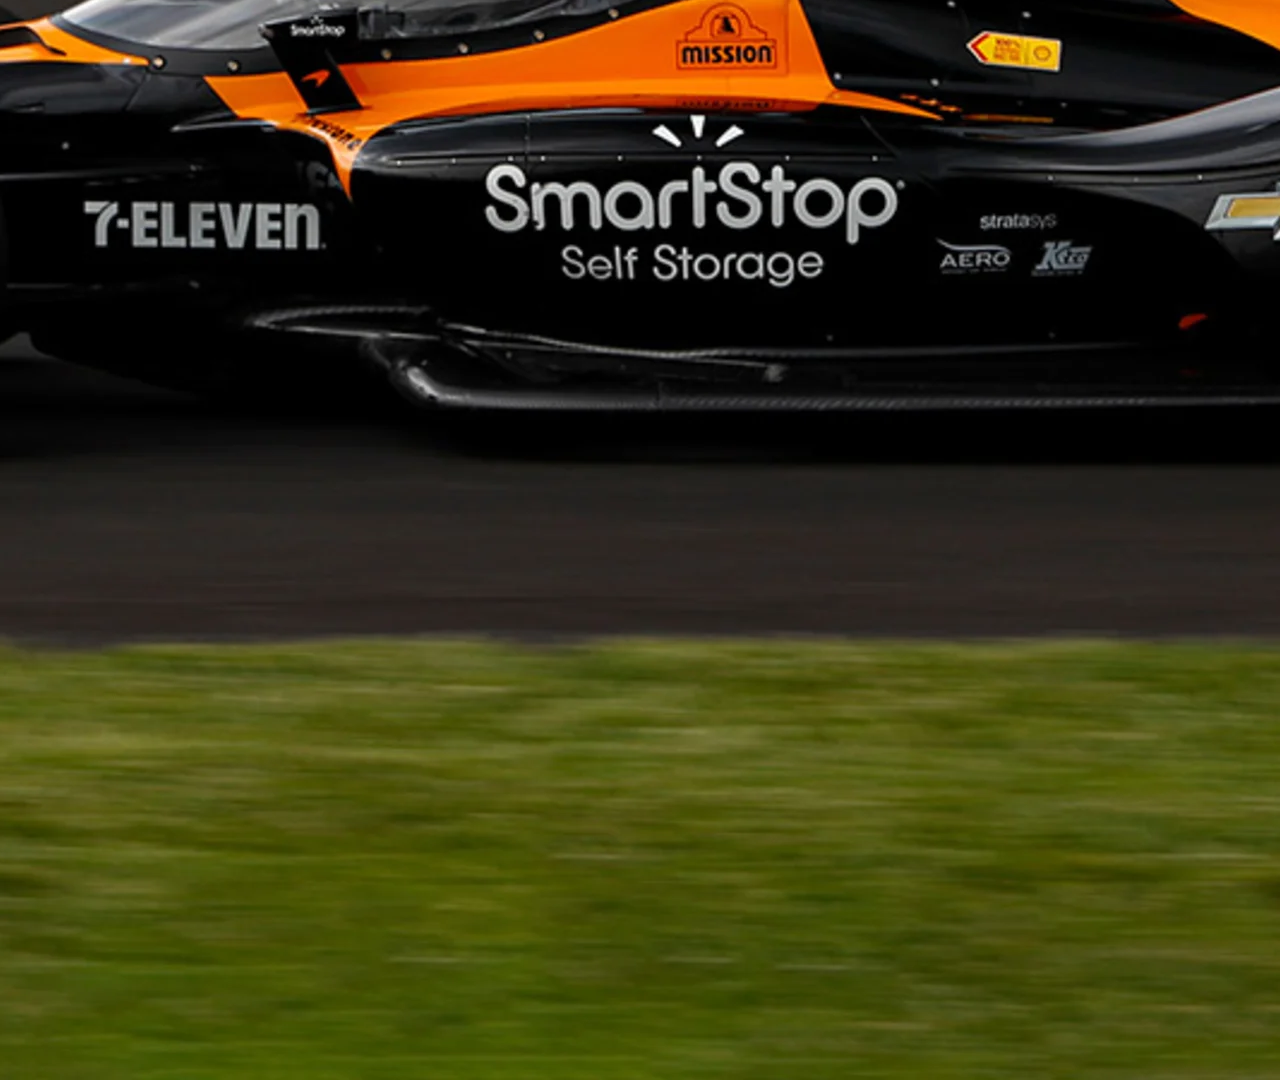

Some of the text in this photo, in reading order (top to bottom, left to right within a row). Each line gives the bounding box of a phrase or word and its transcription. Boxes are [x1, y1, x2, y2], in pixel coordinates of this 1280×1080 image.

[290, 23, 346, 38] SmartStop
[484, 163, 900, 245] SmartStop
[560, 244, 825, 288] Self Storage
[939, 252, 1011, 268] AERO
